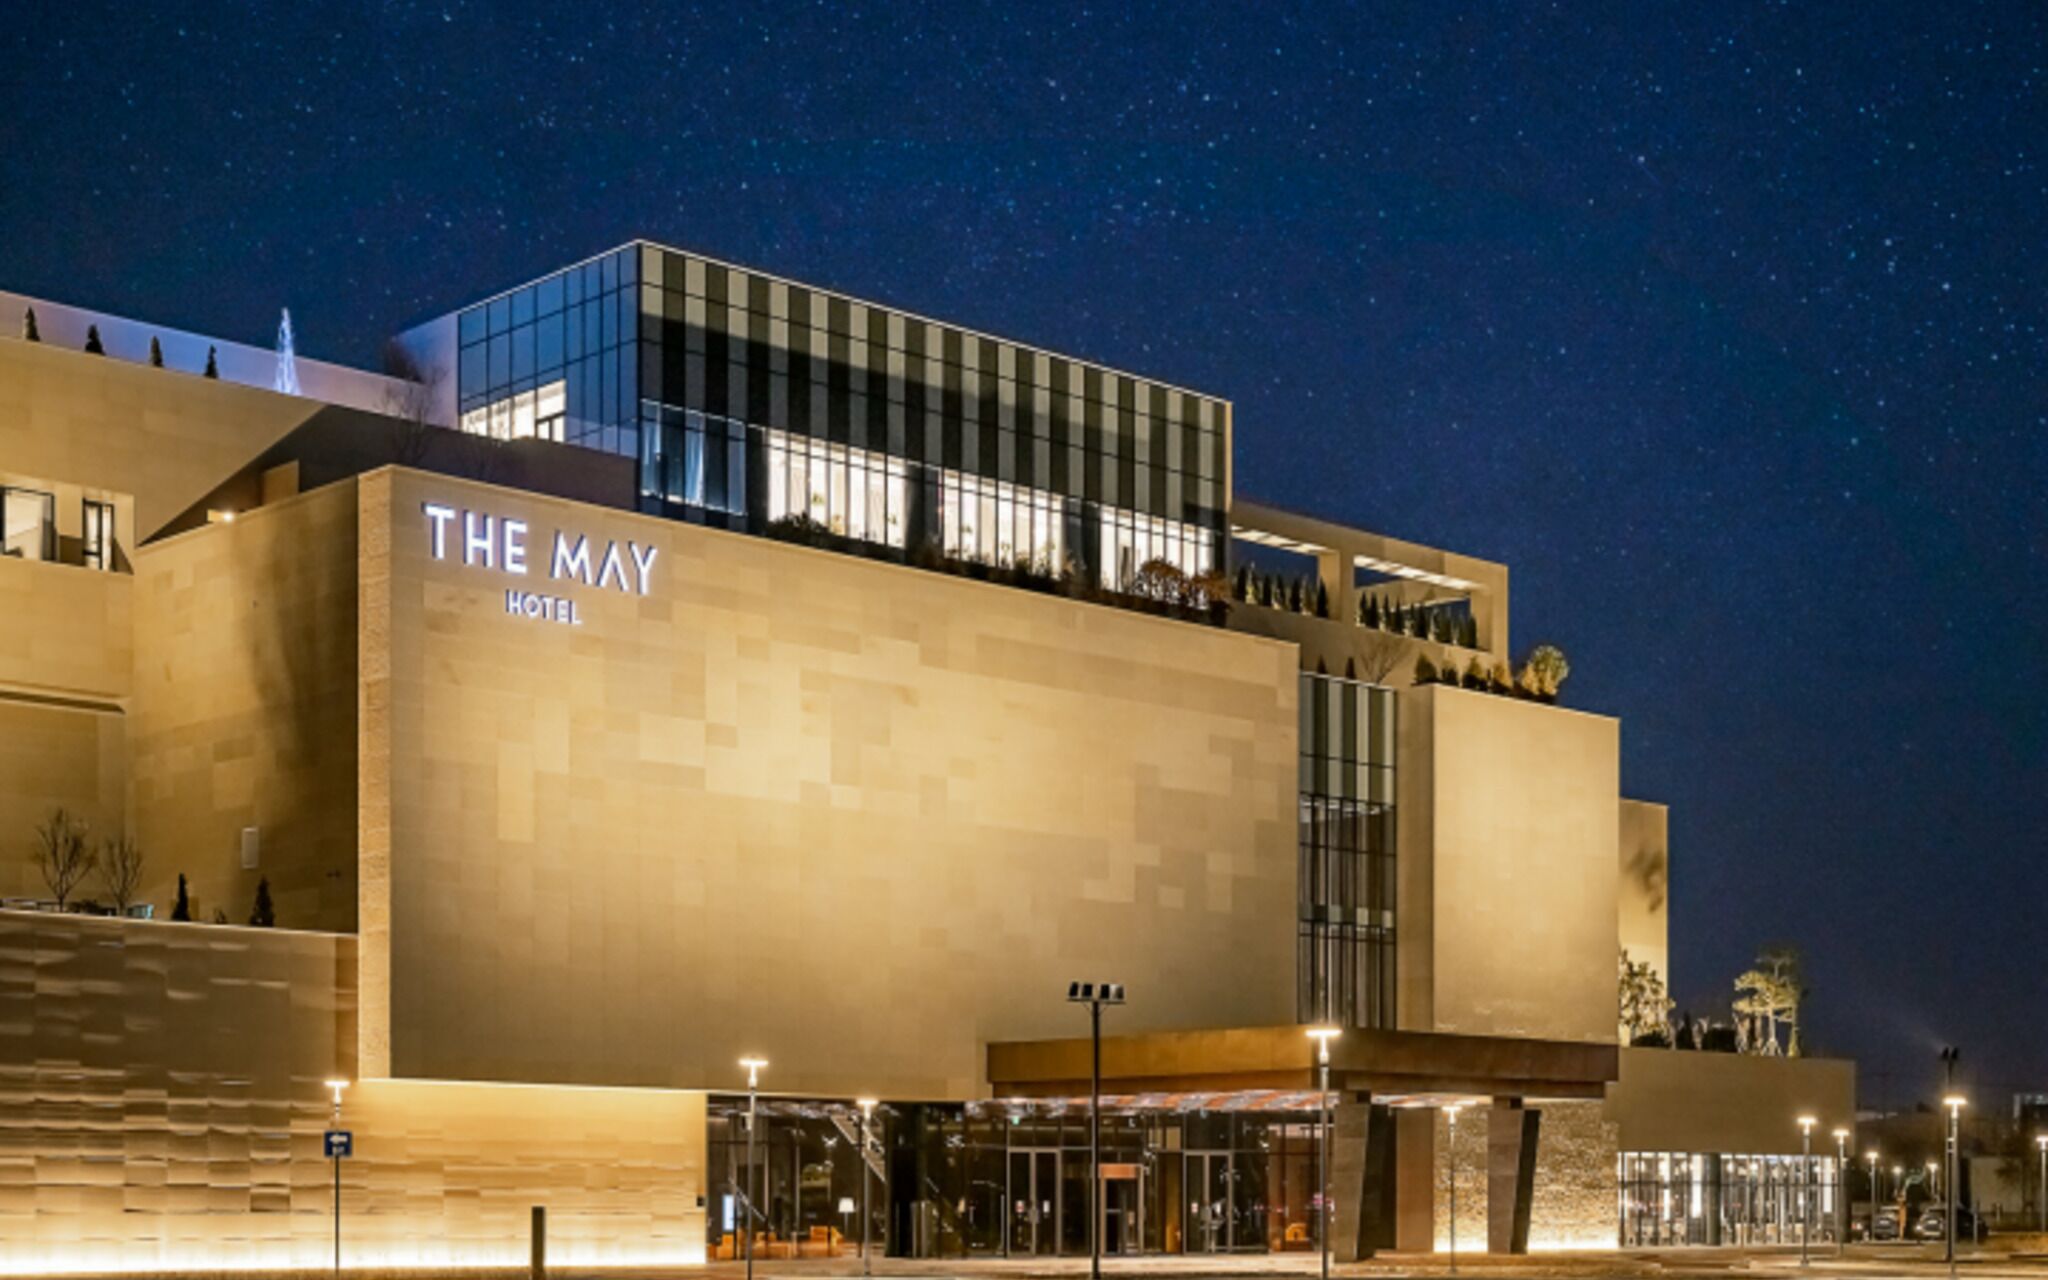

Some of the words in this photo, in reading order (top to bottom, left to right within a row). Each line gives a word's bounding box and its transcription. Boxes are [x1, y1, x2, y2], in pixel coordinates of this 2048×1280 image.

[423, 503, 528, 574] THE
[550, 530, 658, 596] MAY
[506, 590, 582, 625] HOTEL
